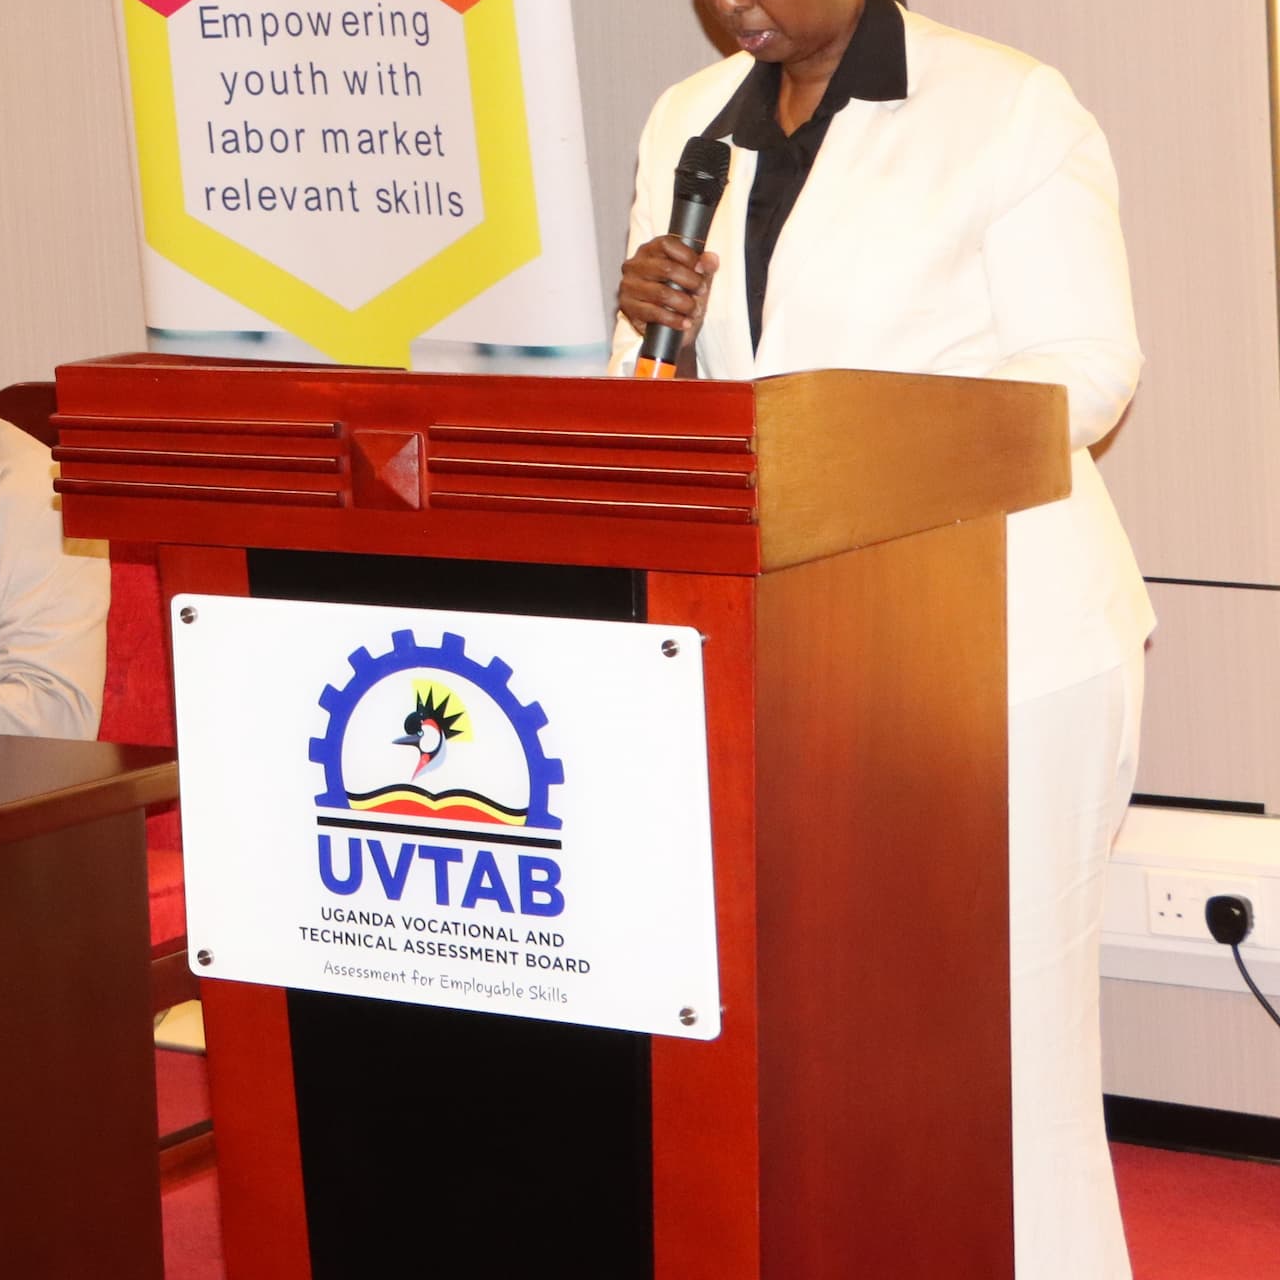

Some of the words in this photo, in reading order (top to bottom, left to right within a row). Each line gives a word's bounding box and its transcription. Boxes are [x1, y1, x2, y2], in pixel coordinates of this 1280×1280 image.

[199, 3, 431, 46] Empowering
[220, 61, 328, 105] youth
[343, 61, 422, 97] with
[208, 121, 305, 154] labor
[321, 121, 445, 157] market
[205, 178, 360, 213] relevant
[376, 180, 464, 217] skills
[318, 834, 565, 918] UVTAB
[321, 907, 395, 929] UGANDA
[402, 915, 519, 944] VOCATIONAL
[525, 926, 564, 948] AND
[299, 927, 397, 952] TECHNICAL
[403, 935, 518, 966] ASSESSMENT
[526, 950, 591, 974] BOARD
[323, 960, 407, 985] Assessment
[411, 969, 435, 990] for
[440, 974, 525, 1002] Employable
[529, 984, 568, 1005] Skills
